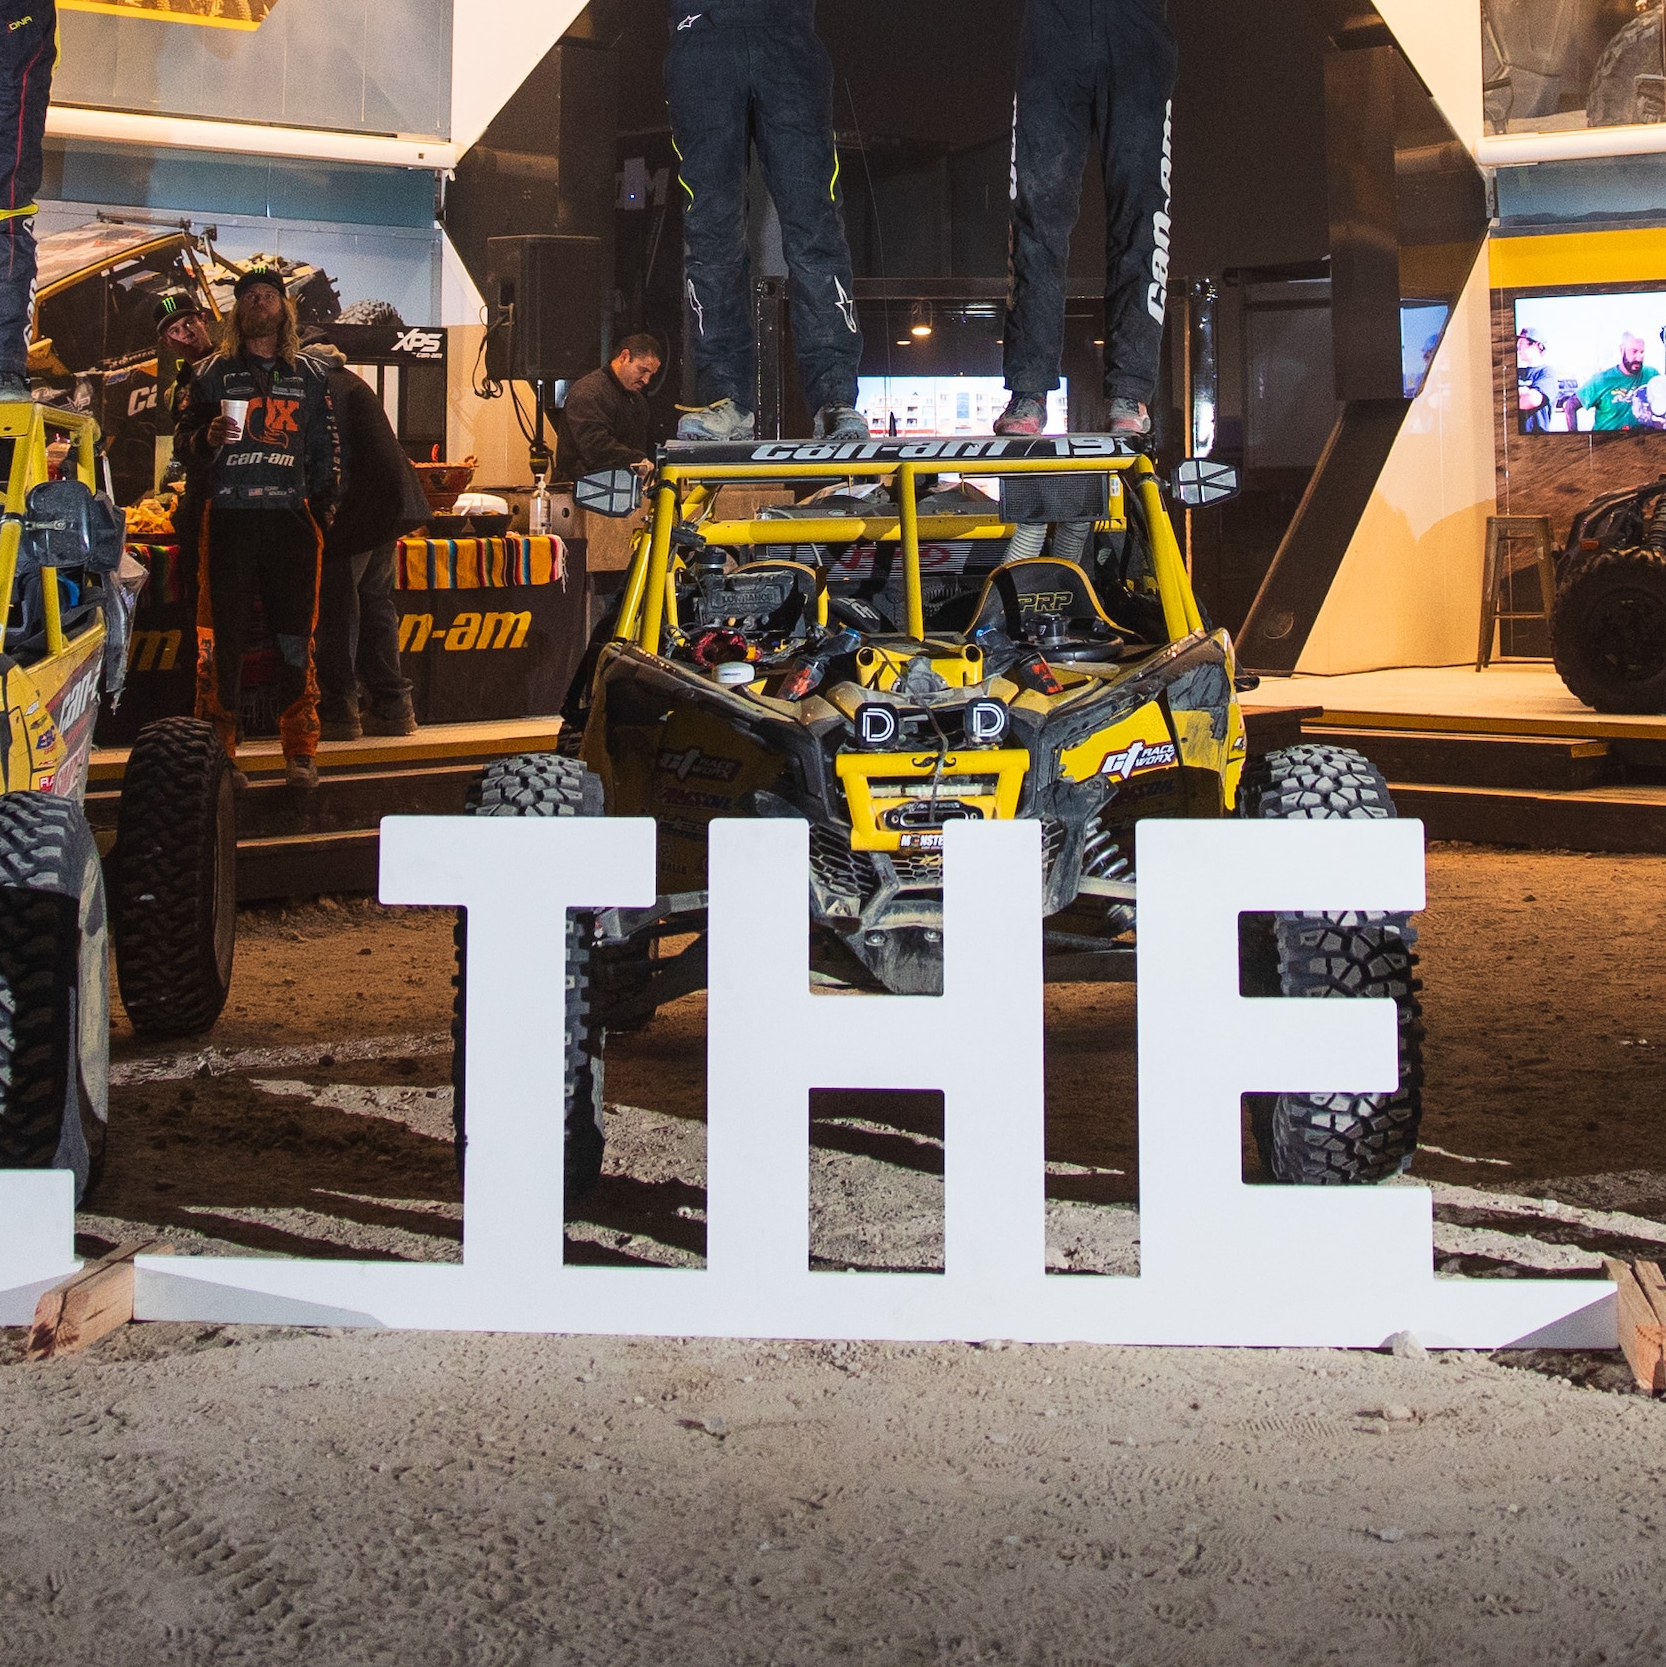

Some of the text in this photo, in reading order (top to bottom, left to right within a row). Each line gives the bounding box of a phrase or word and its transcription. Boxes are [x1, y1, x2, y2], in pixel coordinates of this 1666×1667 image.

[8, 15, 33, 32] DNA
[391, 328, 443, 352] XPS
[226, 451, 295, 467] can-am
[750, 438, 1009, 462] can-am
[1018, 591, 1074, 613] PRP
[398, 610, 532, 653] n-am
[1136, 751, 1176, 767] WORX
[1141, 743, 1175, 758] RACE
[379, 816, 1433, 1278] THE
